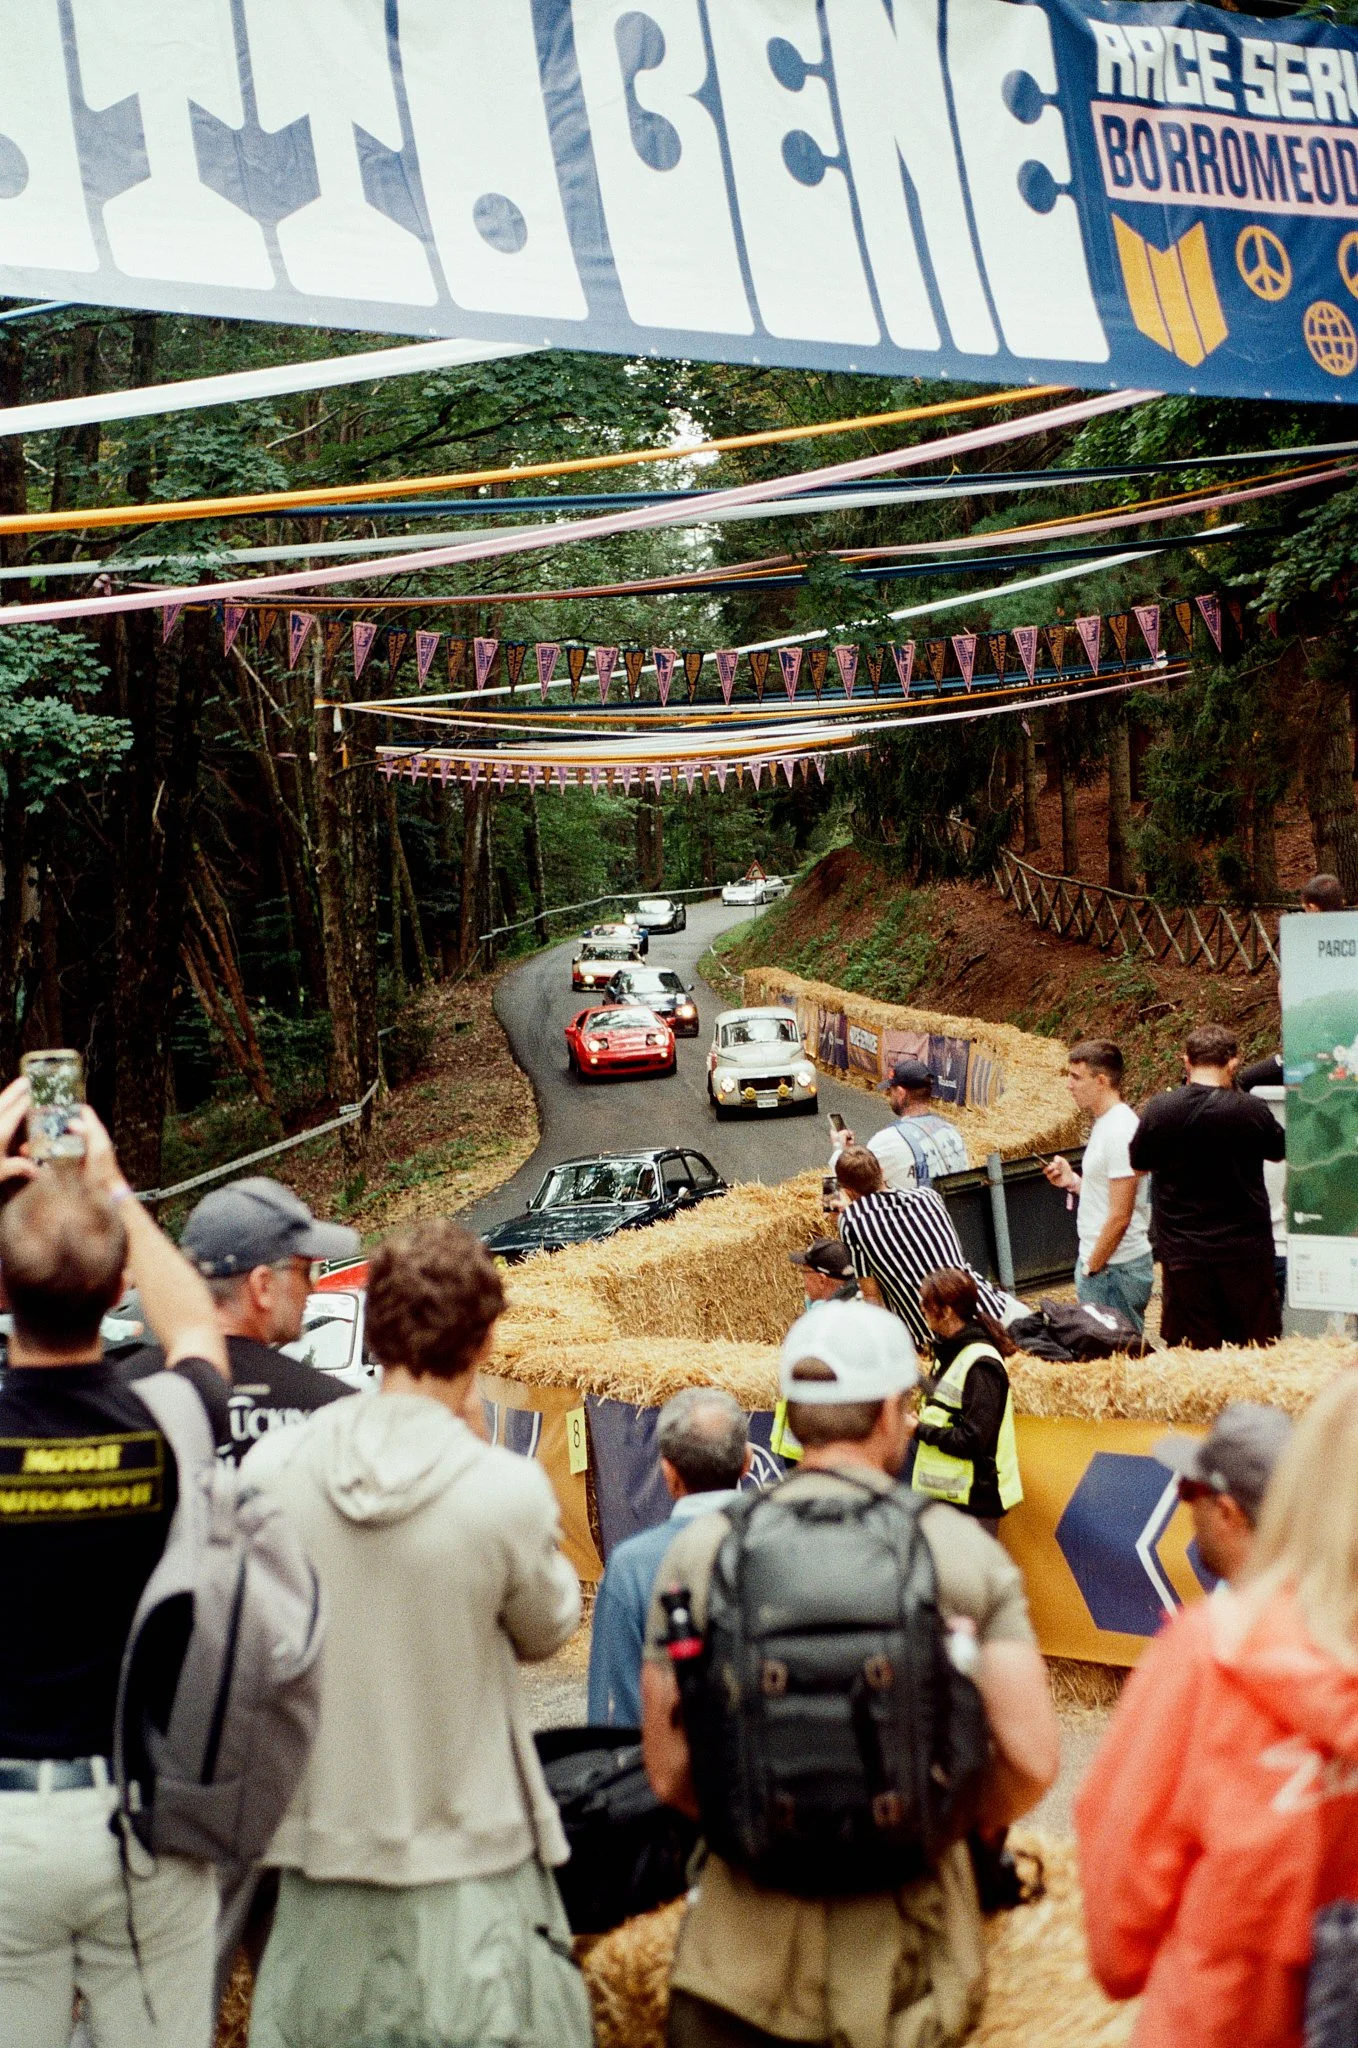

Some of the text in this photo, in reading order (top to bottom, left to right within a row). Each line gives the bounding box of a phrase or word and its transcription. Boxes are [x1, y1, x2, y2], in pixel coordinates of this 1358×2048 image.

[1087, 18, 1237, 111] RACE
[1317, 939, 1357, 958] PARCO
[573, 1419, 581, 1448] 8
